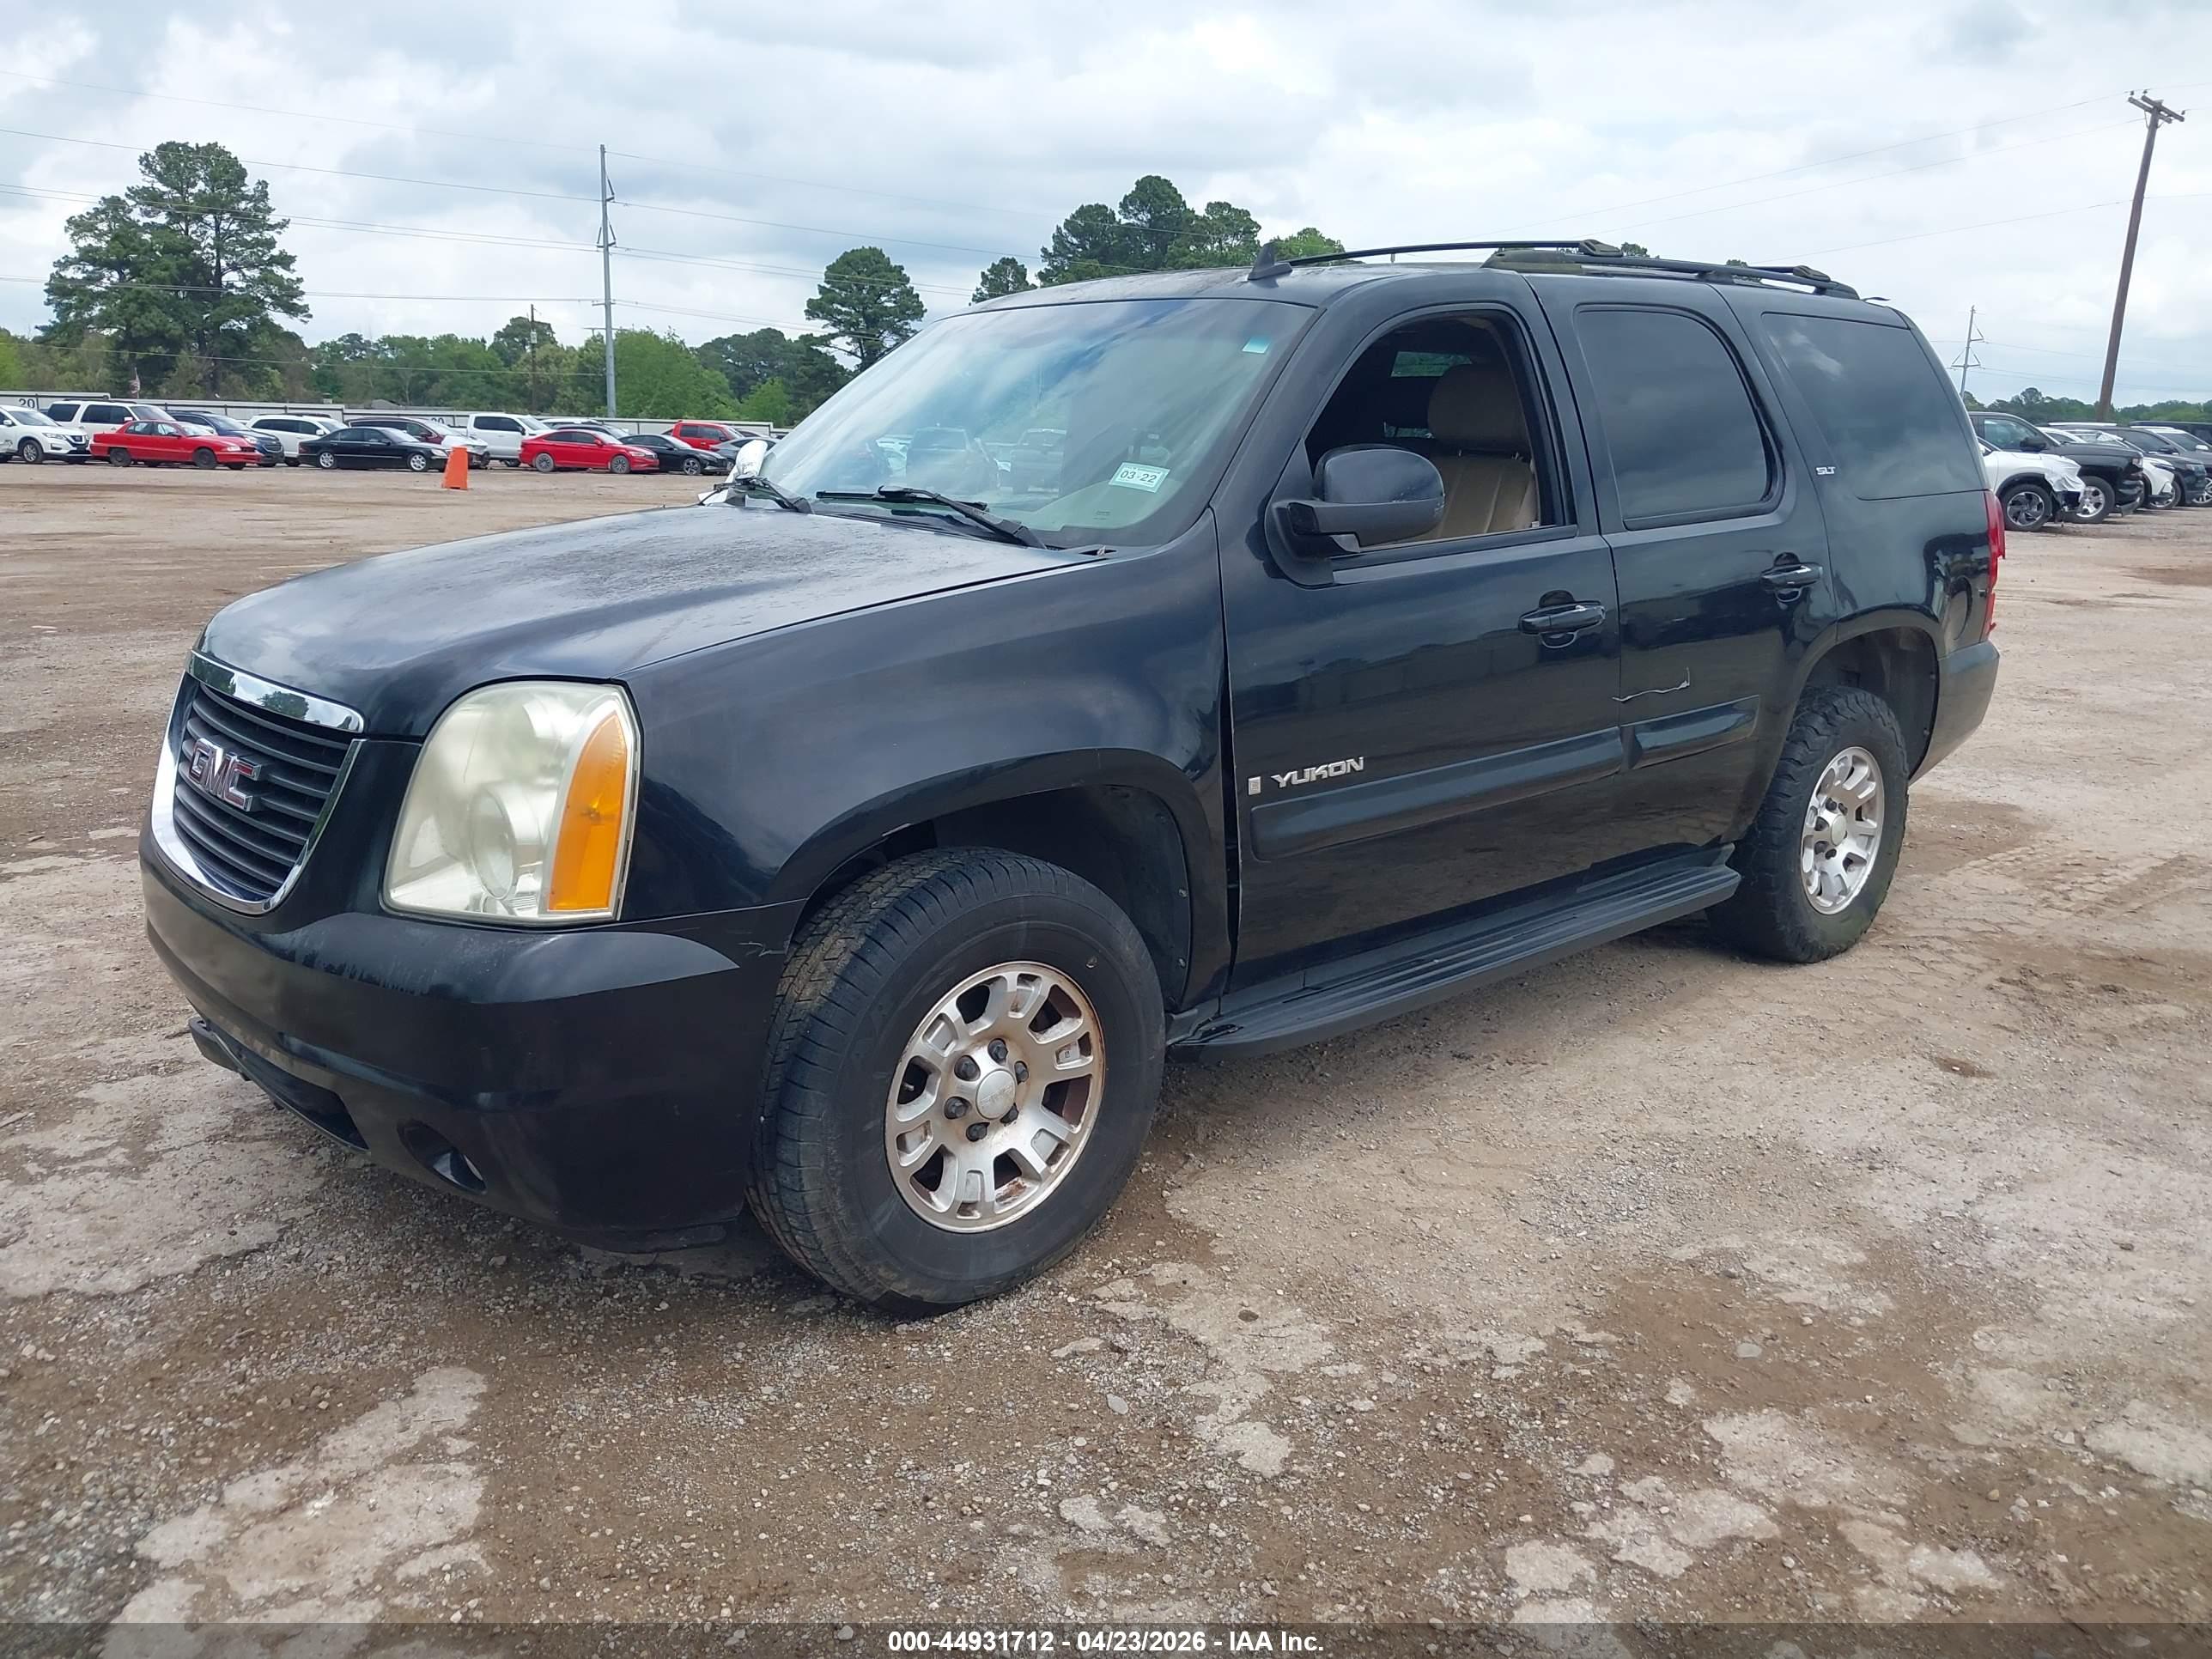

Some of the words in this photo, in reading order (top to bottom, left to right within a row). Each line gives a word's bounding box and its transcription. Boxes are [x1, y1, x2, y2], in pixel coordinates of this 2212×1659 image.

[19, 398, 35, 409] 20
[1816, 466, 1836, 475] SLT
[190, 738, 262, 812] GMC
[1271, 757, 1364, 788] YUKON
